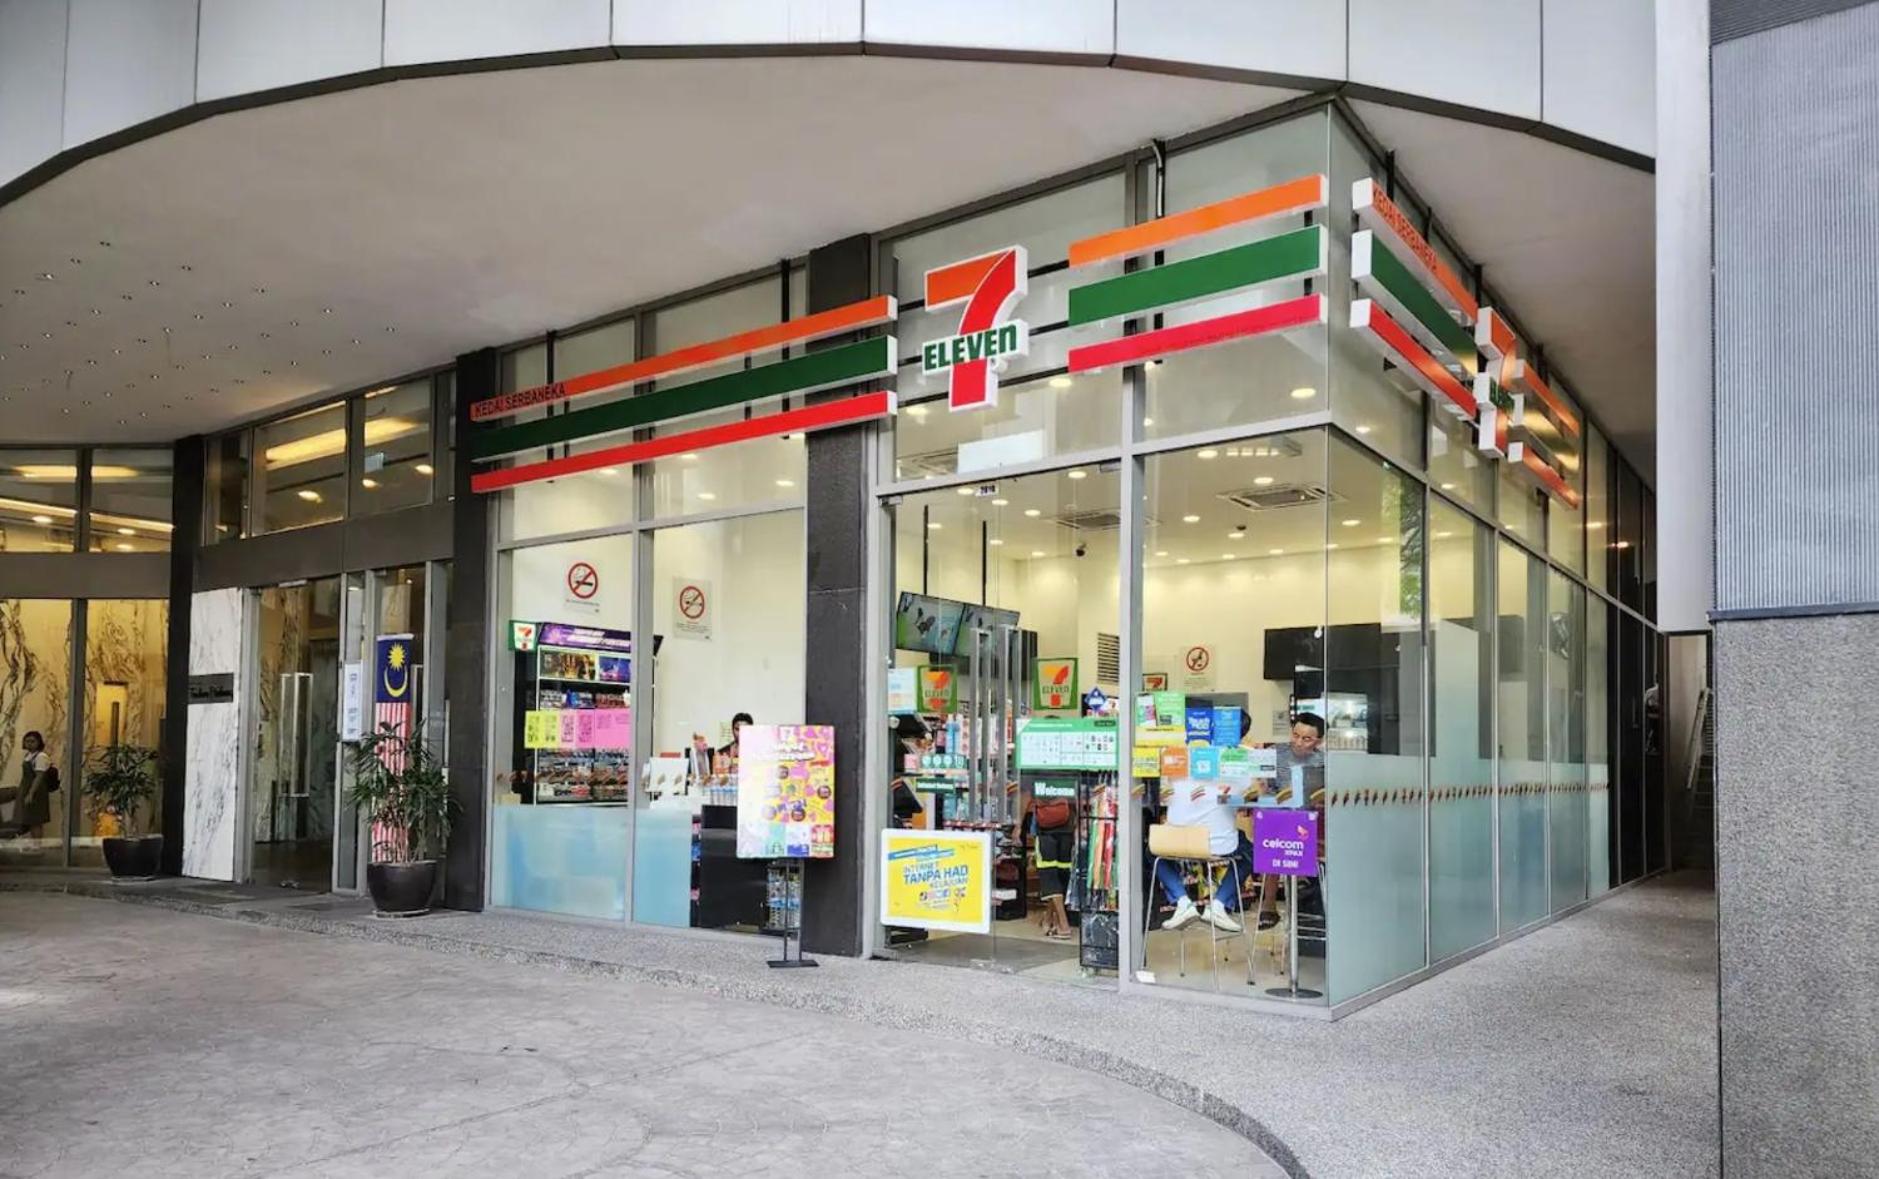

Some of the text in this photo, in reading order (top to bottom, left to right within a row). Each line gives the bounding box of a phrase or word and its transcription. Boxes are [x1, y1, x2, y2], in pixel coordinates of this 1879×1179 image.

[927, 250, 1016, 407] 7
[474, 383, 566, 418] KEDAI SERBANEKA
[1034, 781, 1075, 797] Welcome
[1262, 838, 1304, 849] celcom
[903, 864, 969, 885] TANPA HAD
